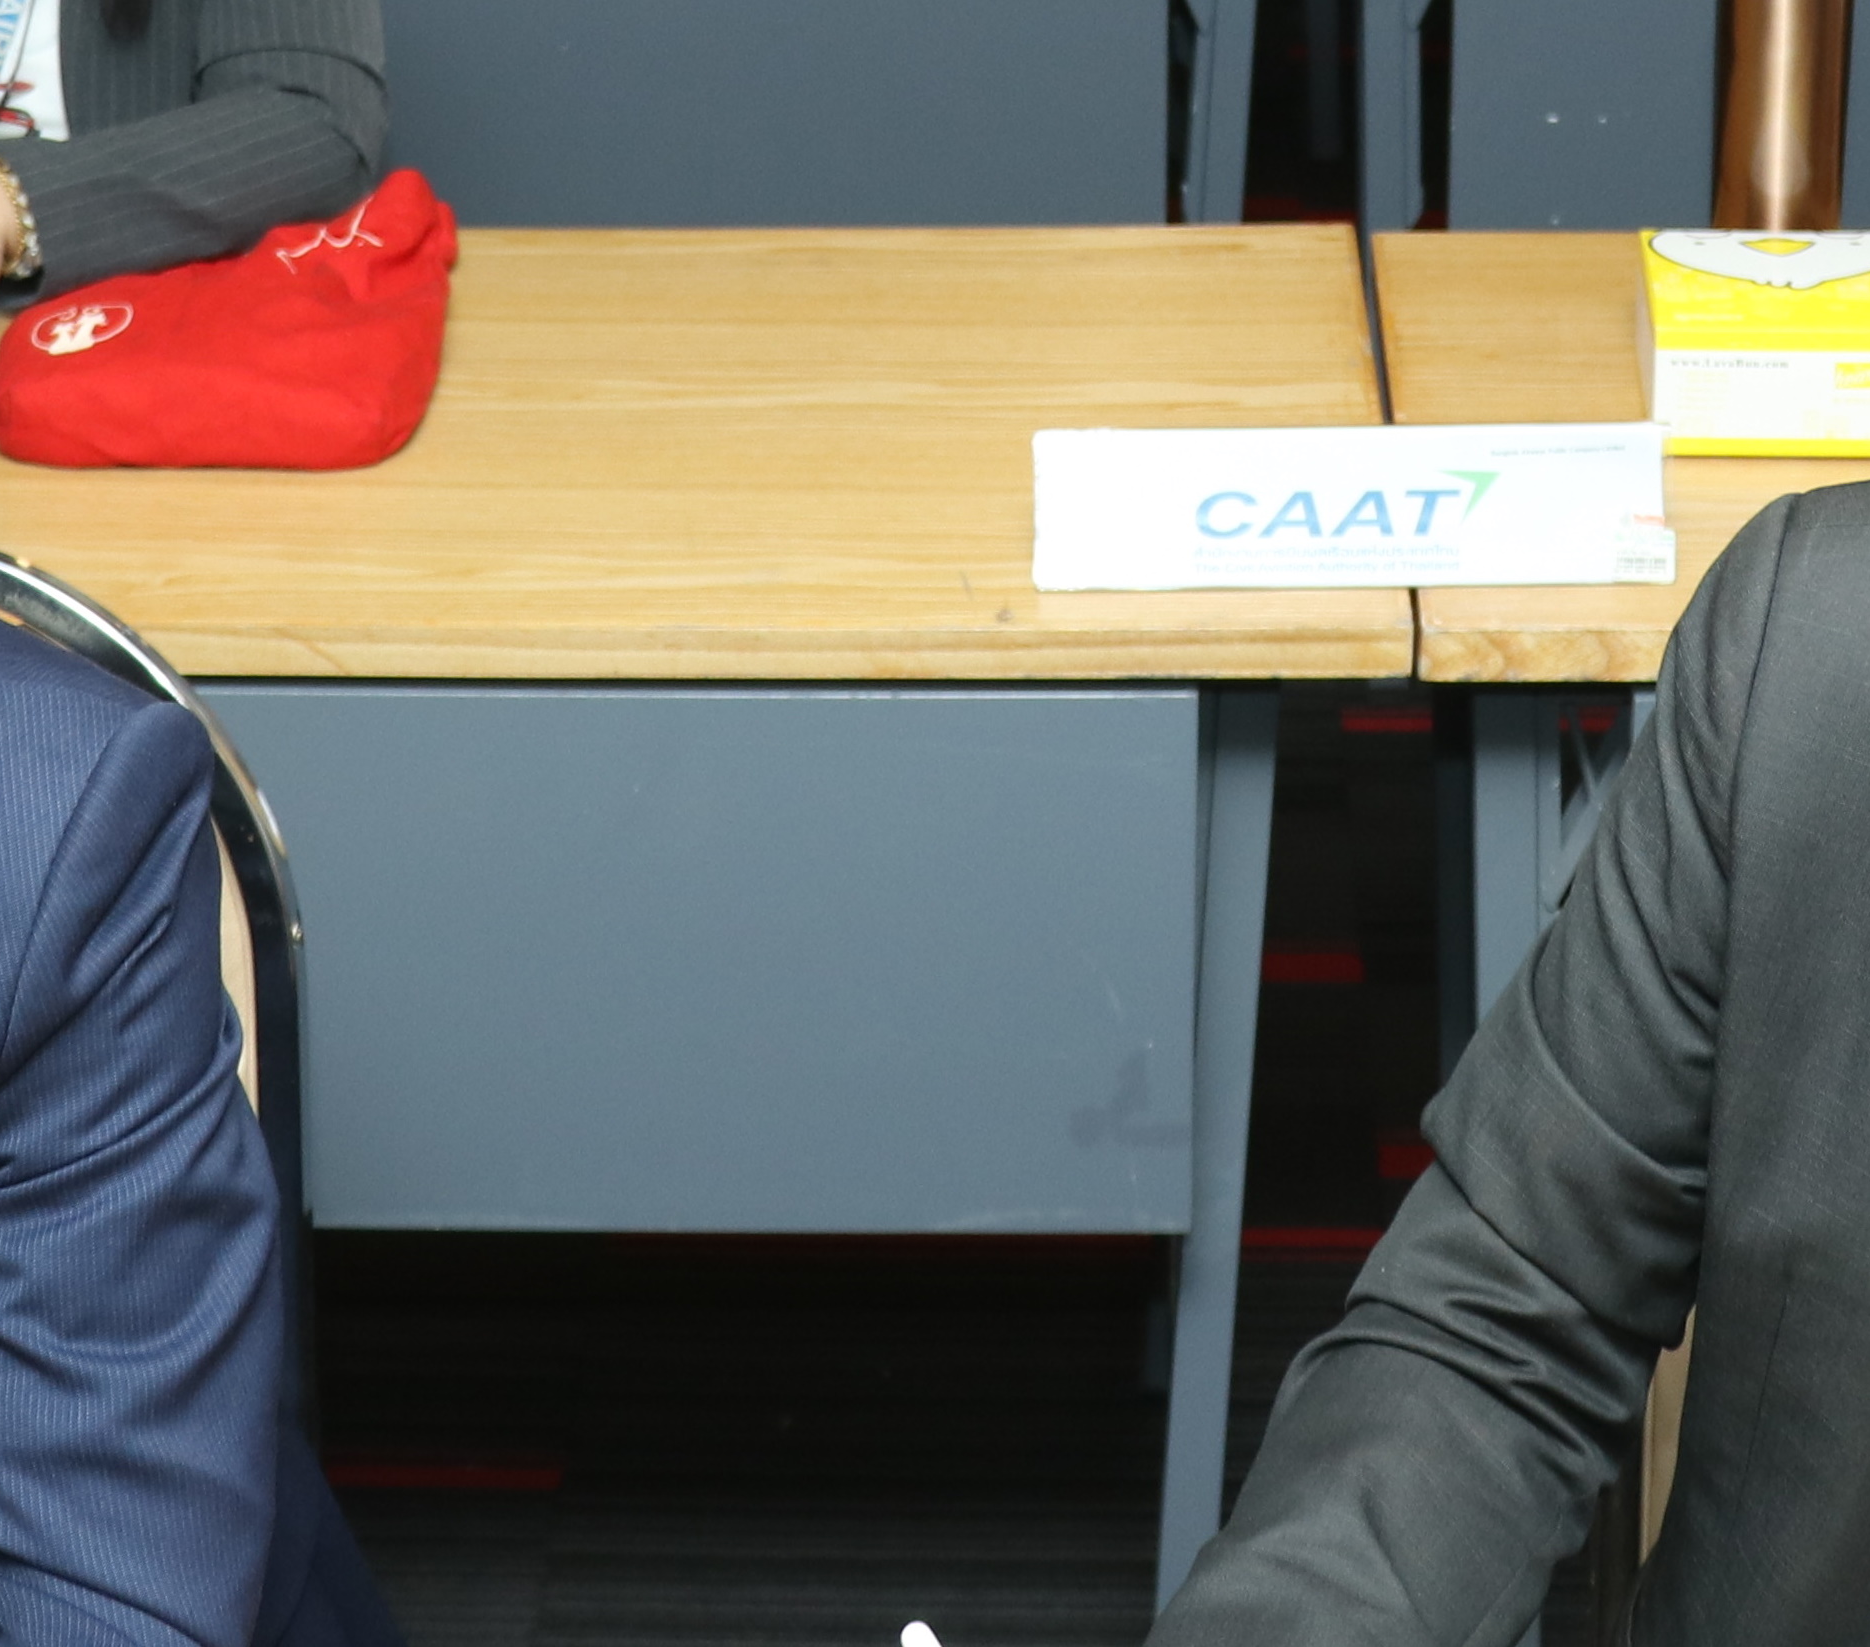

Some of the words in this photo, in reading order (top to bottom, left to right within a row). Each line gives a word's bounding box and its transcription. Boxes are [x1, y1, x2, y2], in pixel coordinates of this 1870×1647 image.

[1195, 490, 1460, 539] CAAT
[1317, 561, 1377, 574] Authority
[1382, 561, 1396, 571] of
[1401, 560, 1460, 571] Thailand
